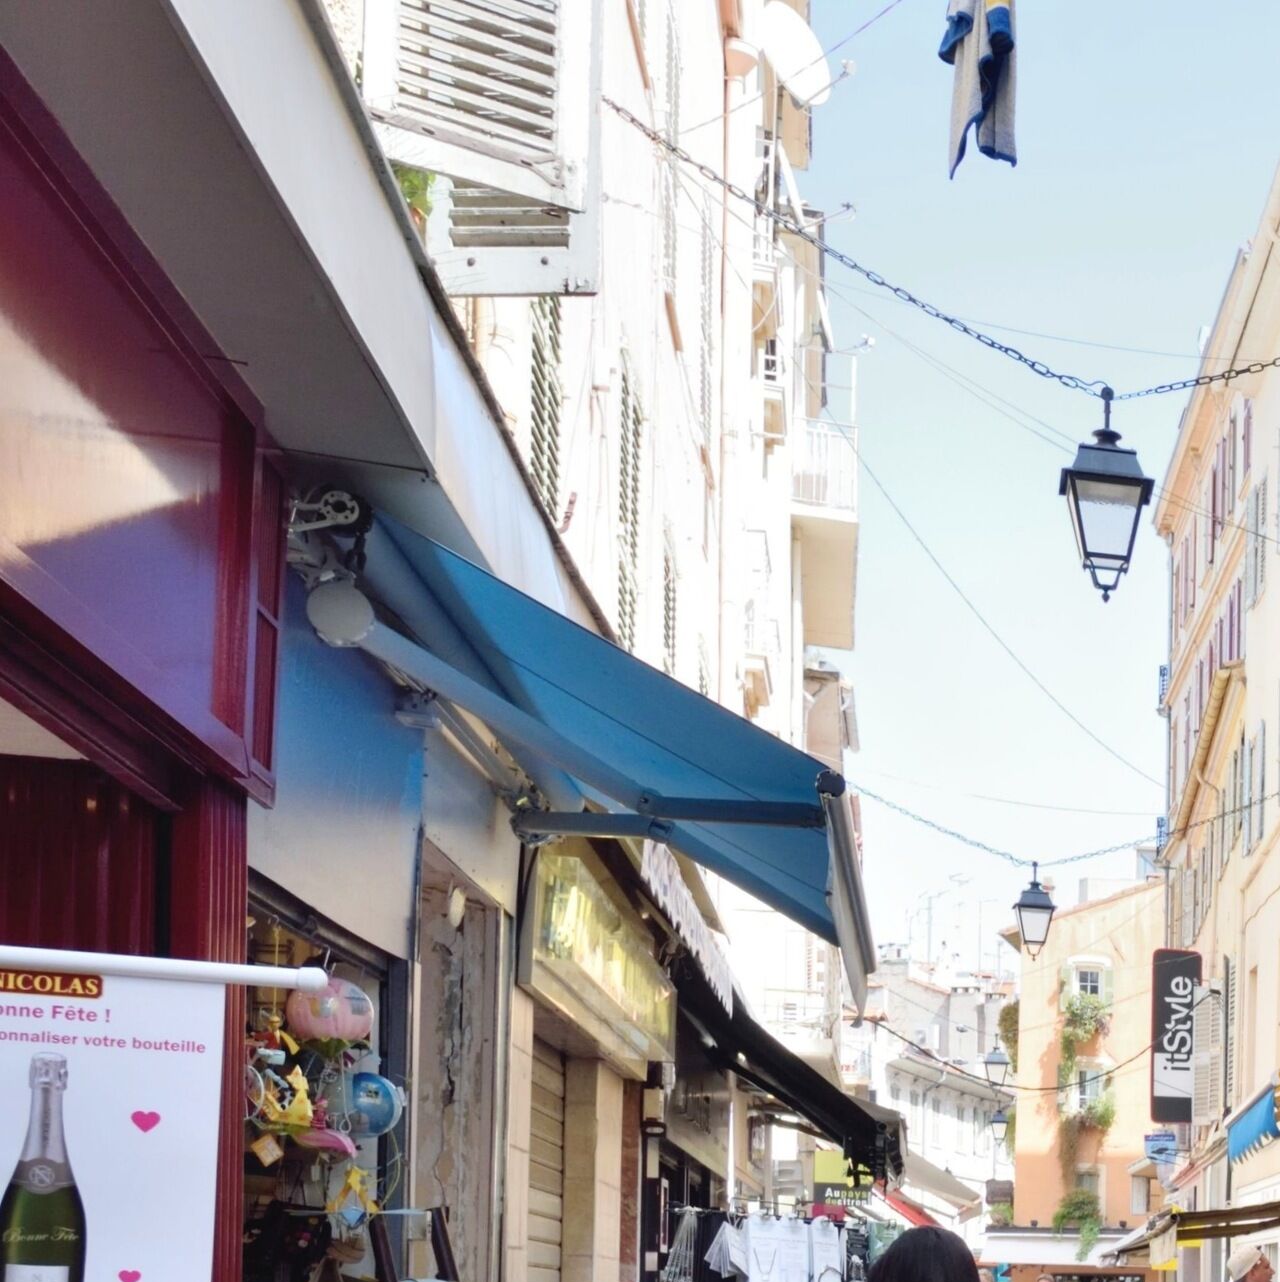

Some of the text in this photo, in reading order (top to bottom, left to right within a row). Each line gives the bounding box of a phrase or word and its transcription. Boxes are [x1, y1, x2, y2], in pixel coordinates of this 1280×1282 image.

[52, 1005, 98, 1022] Fête
[1163, 976, 1194, 1071] itStyle
[84, 1035, 126, 1048] votre
[132, 1037, 206, 1053] bouteille
